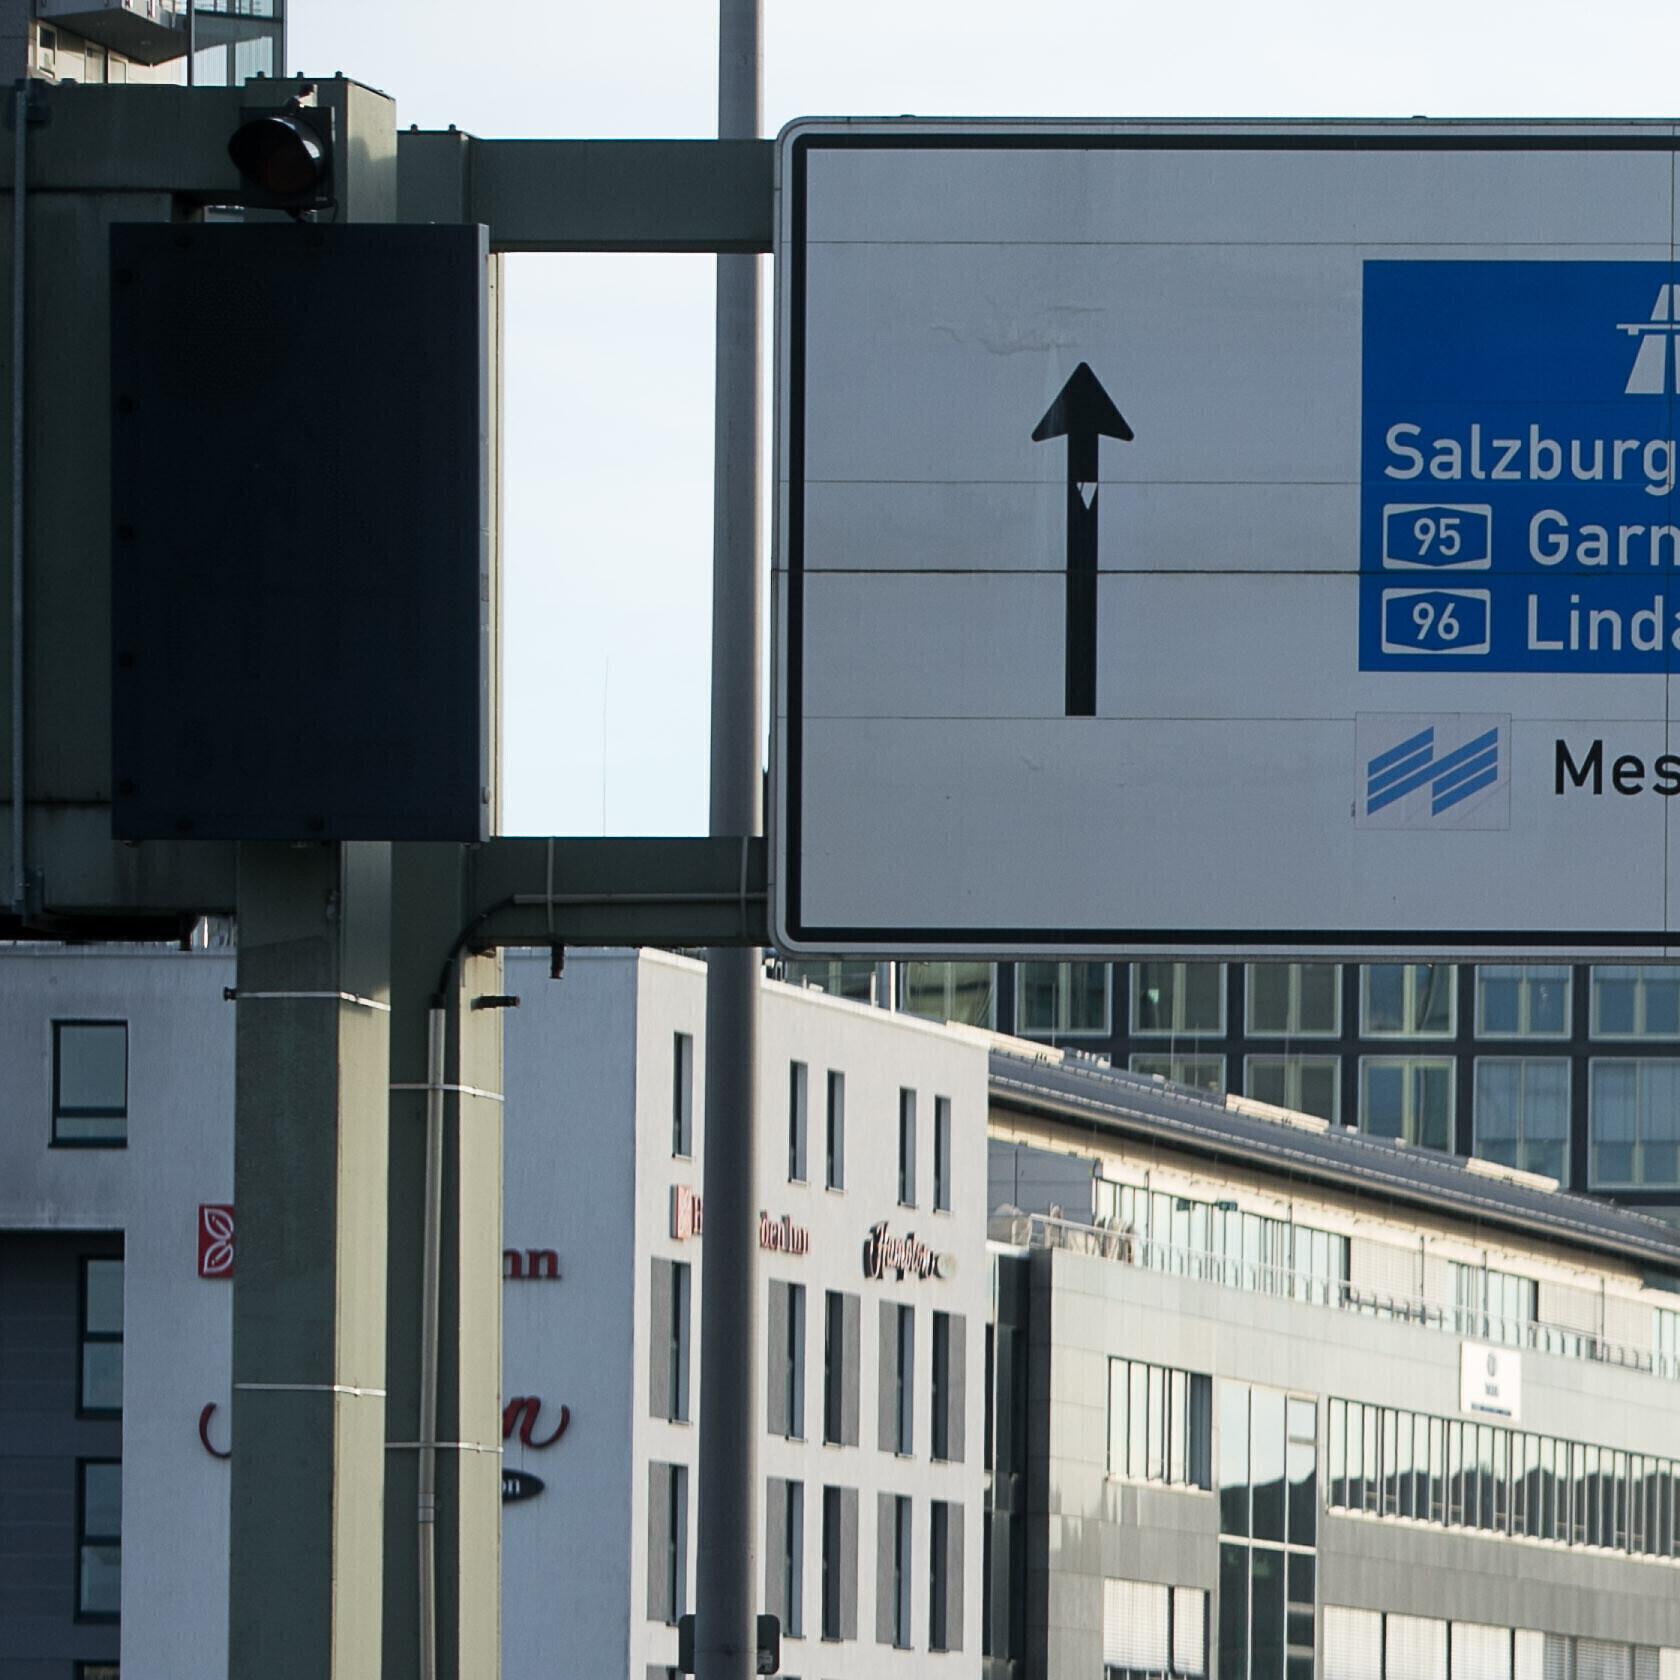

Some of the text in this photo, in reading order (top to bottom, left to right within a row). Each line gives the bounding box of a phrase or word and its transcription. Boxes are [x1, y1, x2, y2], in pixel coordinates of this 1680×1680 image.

[1413, 518, 1462, 556] 95
[1412, 603, 1460, 640] 96
[503, 1248, 562, 1280] nn
